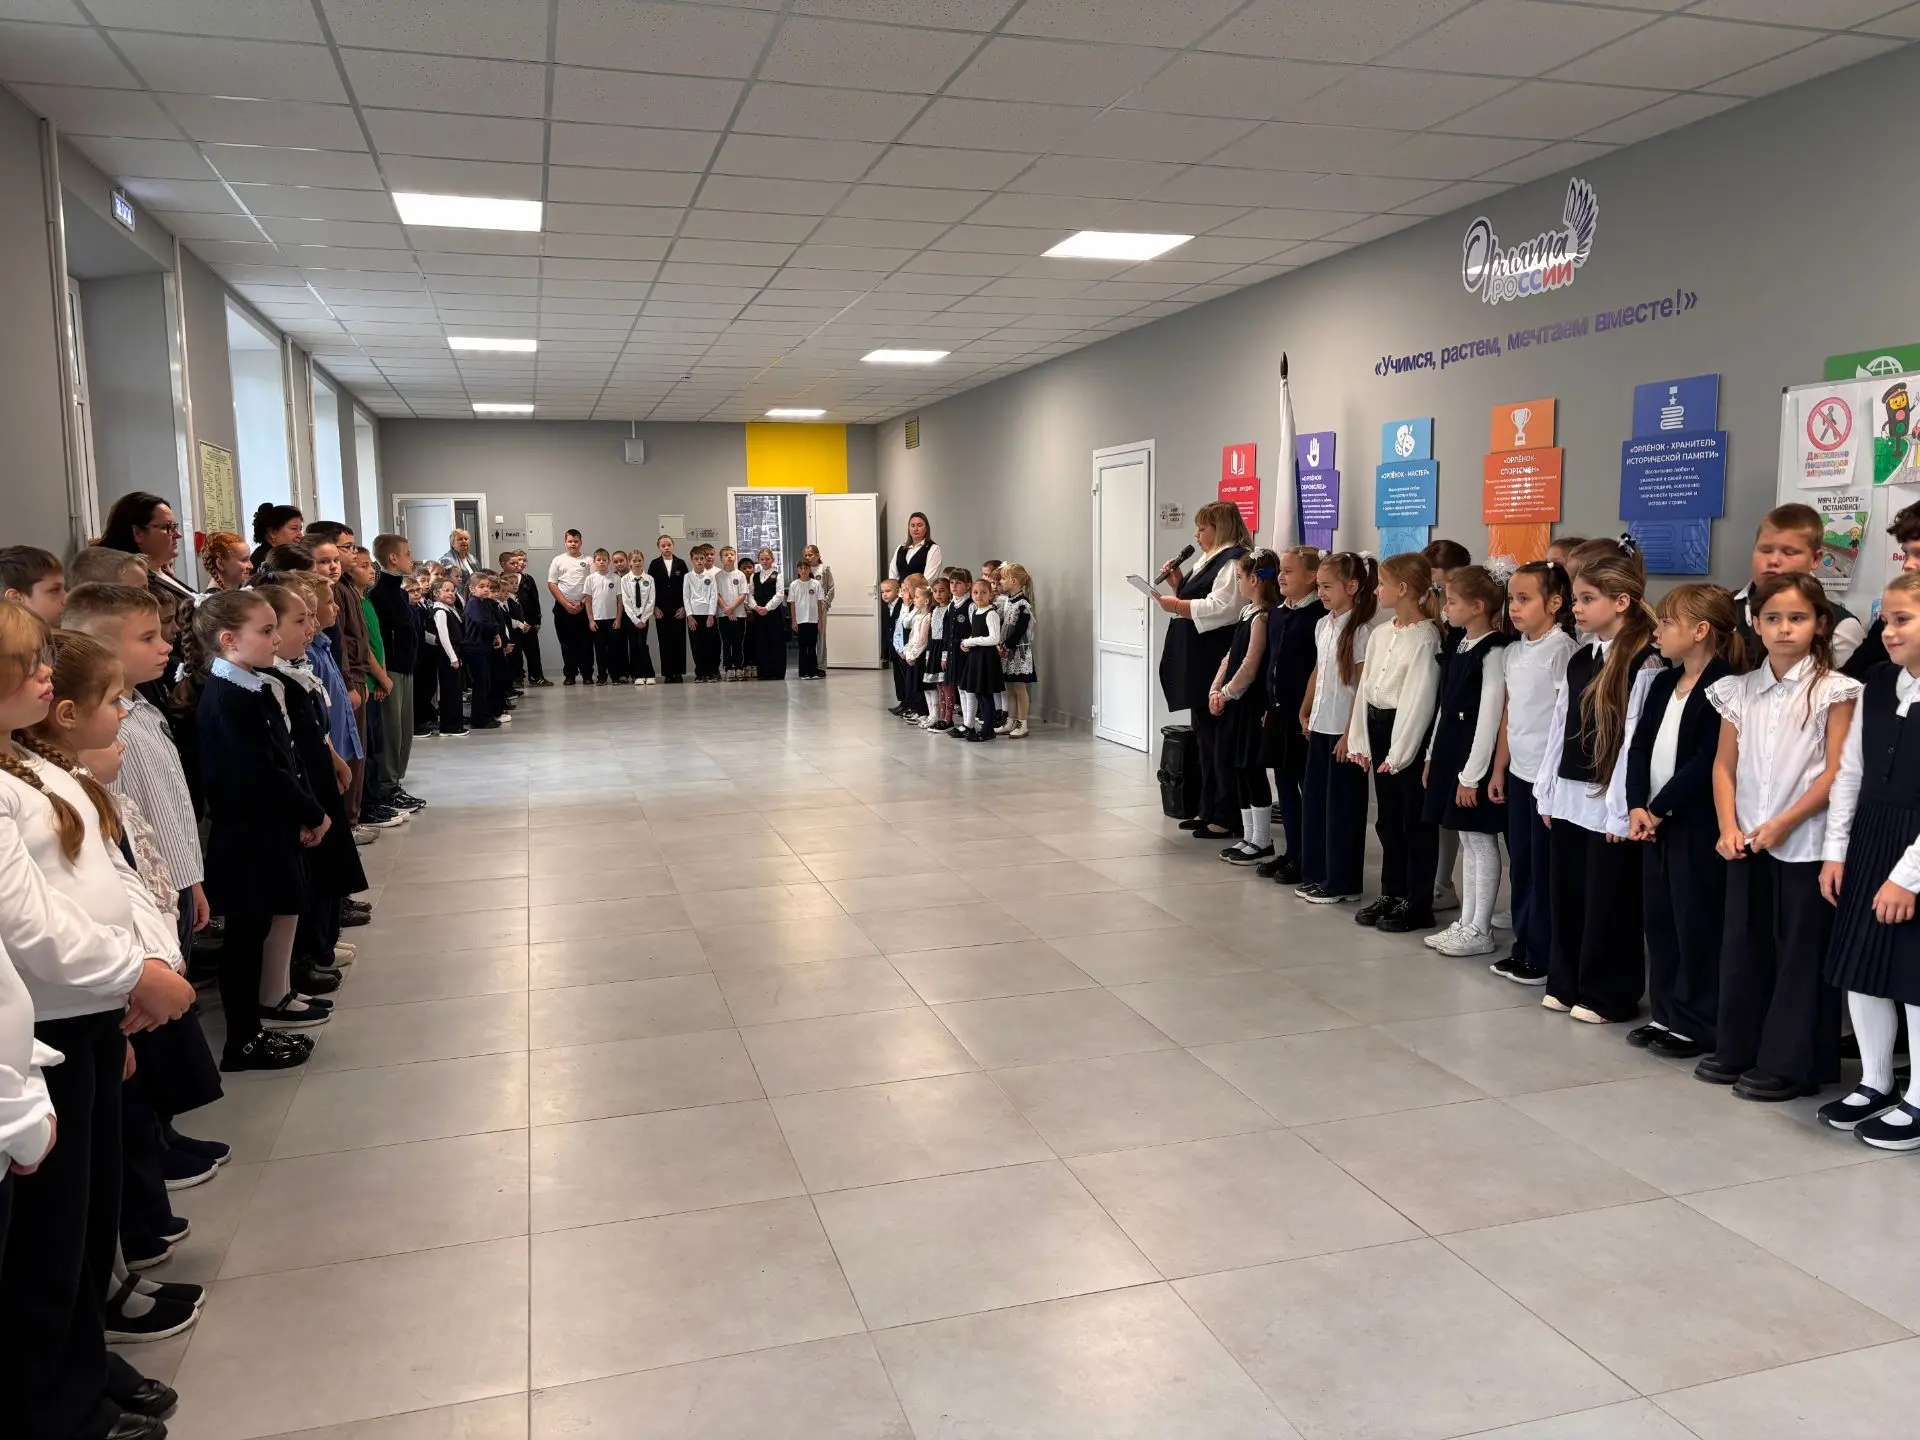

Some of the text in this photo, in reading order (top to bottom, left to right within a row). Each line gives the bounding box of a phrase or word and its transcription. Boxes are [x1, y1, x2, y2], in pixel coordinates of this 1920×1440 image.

[1464, 219, 1570, 300] Орлята
[1493, 260, 1572, 301] РОССИИ
[1374, 288, 1698, 377] «Учимся, растем, мечтаем вместе!»
[1671, 438, 1716, 450] ХРАНИТЕЛЬ
[1626, 450, 1719, 466] ИСТОРИЧЕСКОЙ ПАМЯТИ»
[1822, 503, 1861, 511] ОСТАНОВИСЬ!
[1837, 496, 1860, 504] ДОРОГИ
